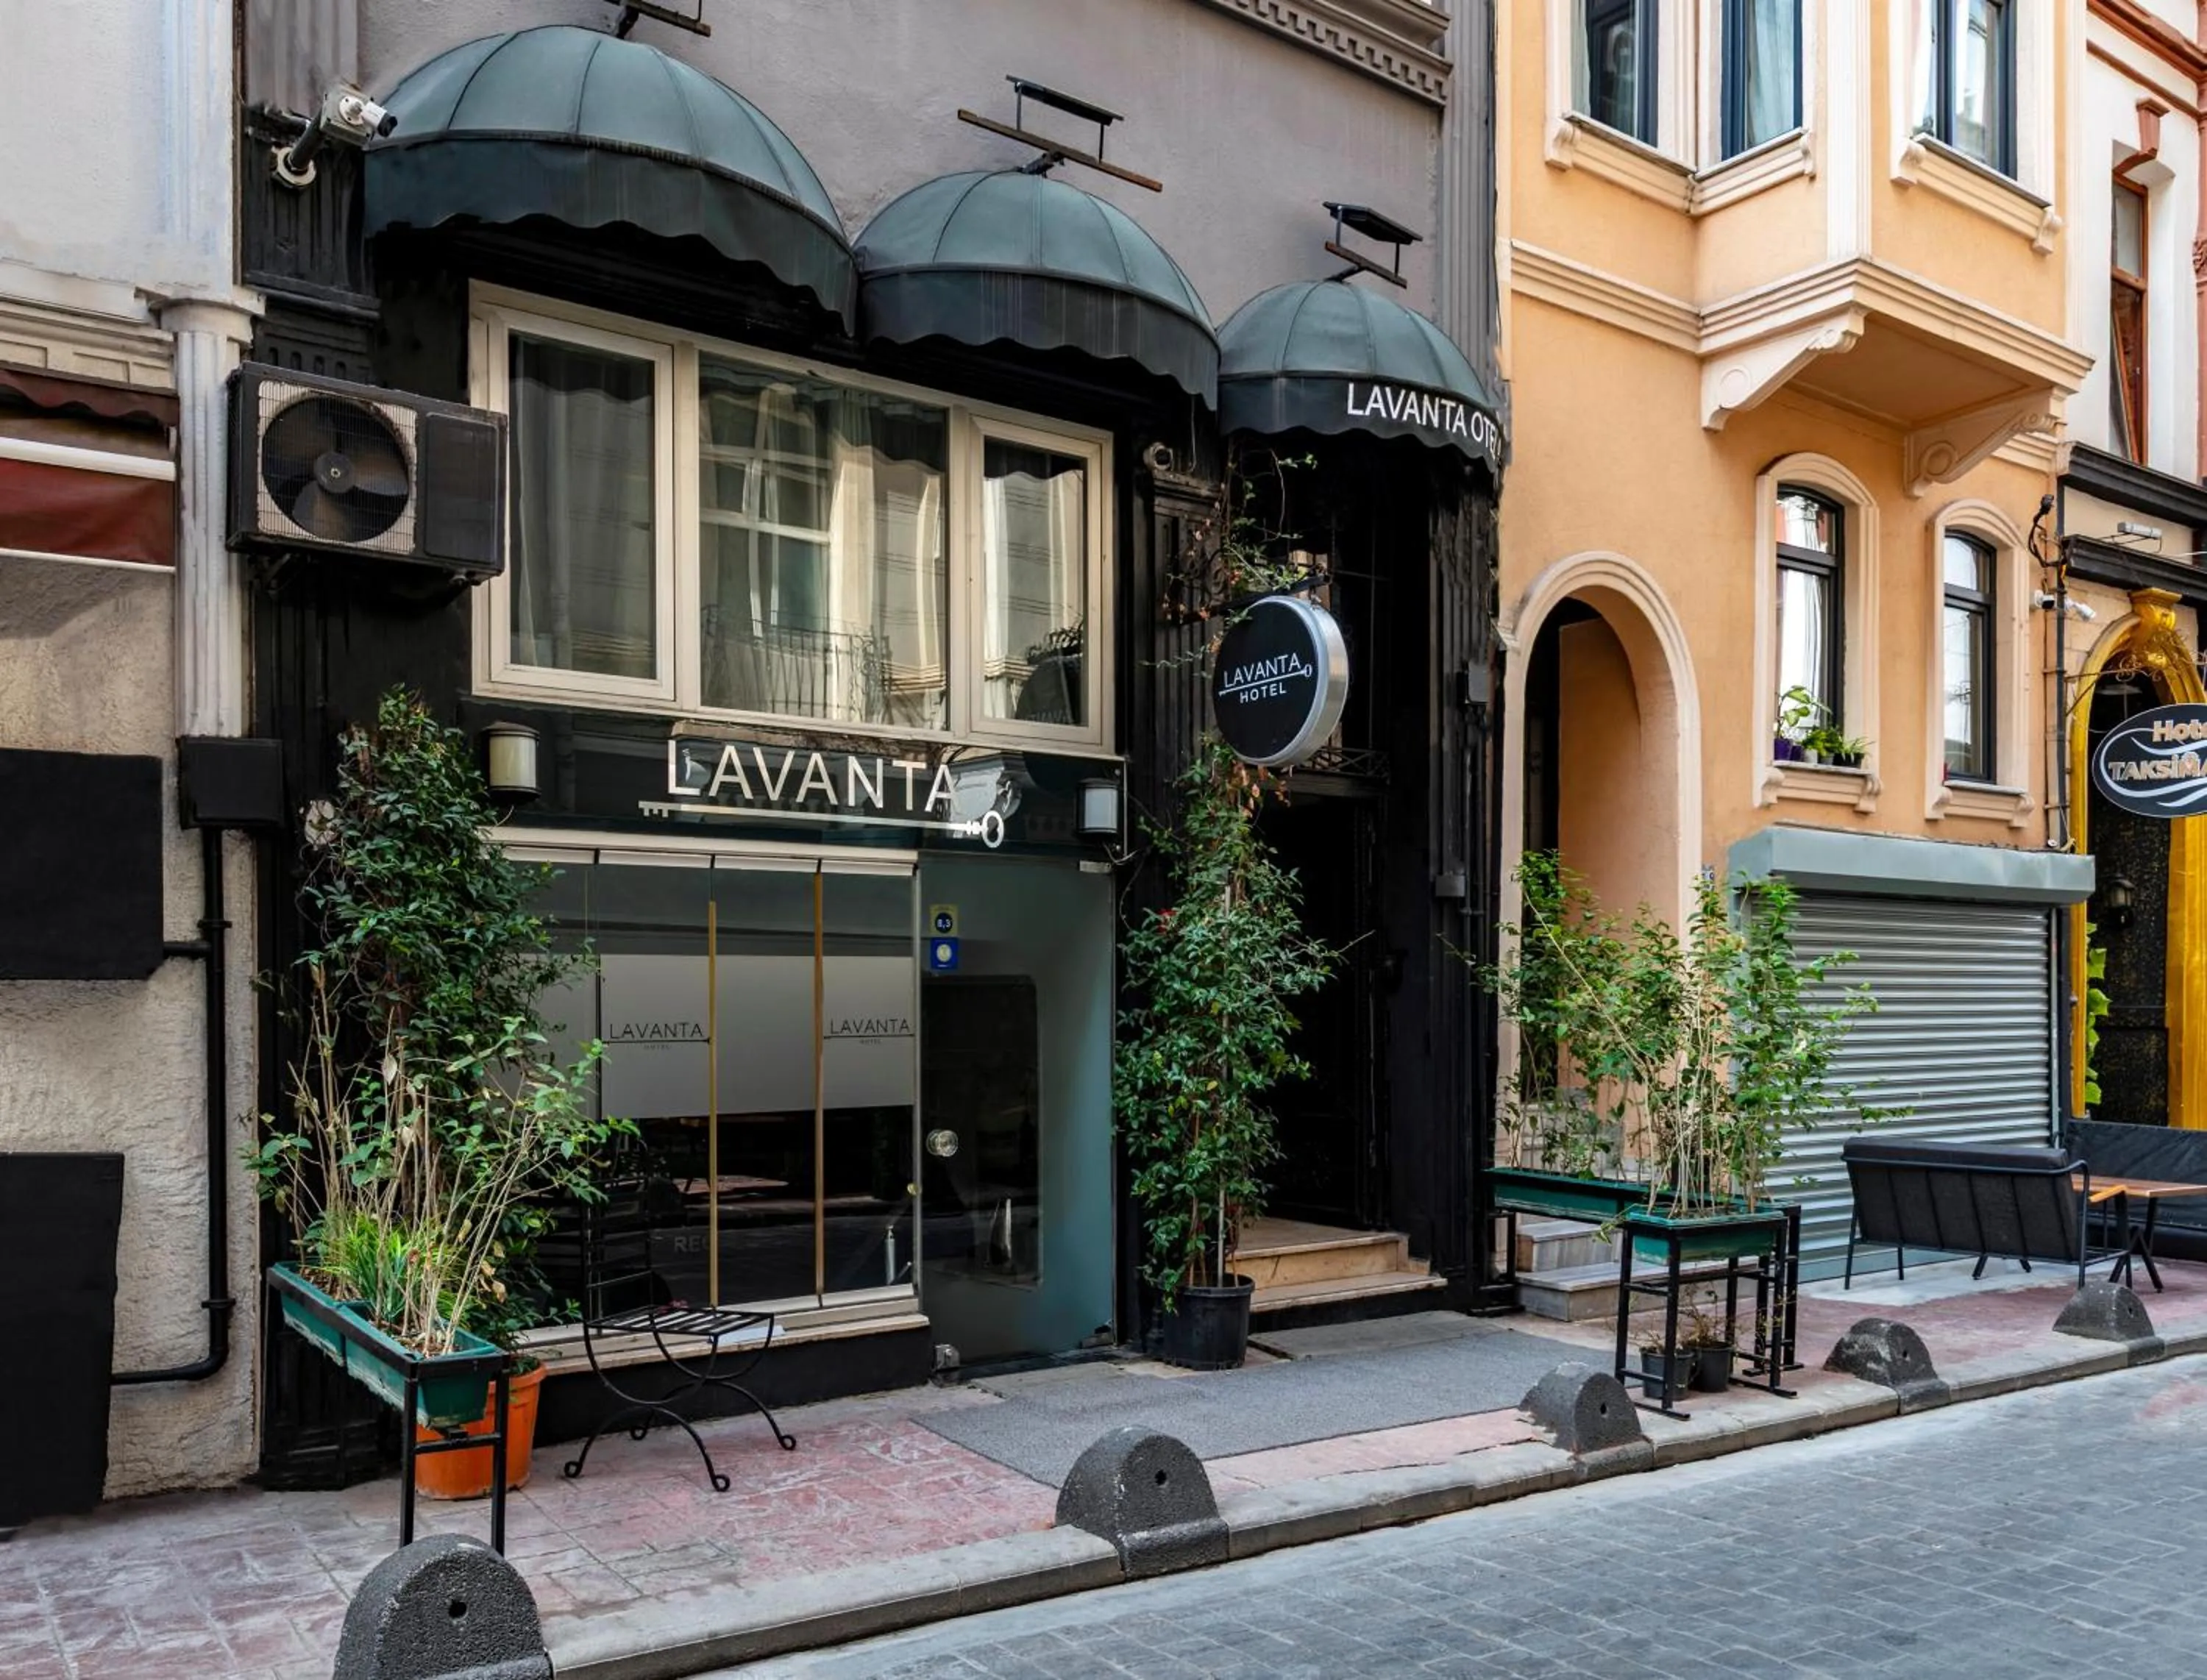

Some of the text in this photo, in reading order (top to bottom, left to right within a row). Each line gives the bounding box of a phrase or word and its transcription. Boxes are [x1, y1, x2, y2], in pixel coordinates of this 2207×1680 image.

[1347, 382, 1467, 436] LAVANTA
[1223, 652, 1301, 688] LAVANTA
[1240, 682, 1287, 704] HOTEL
[668, 740, 959, 813] LAVANTA
[610, 1022, 703, 1039] LAVANTA
[831, 1018, 910, 1034] LAVANTA
